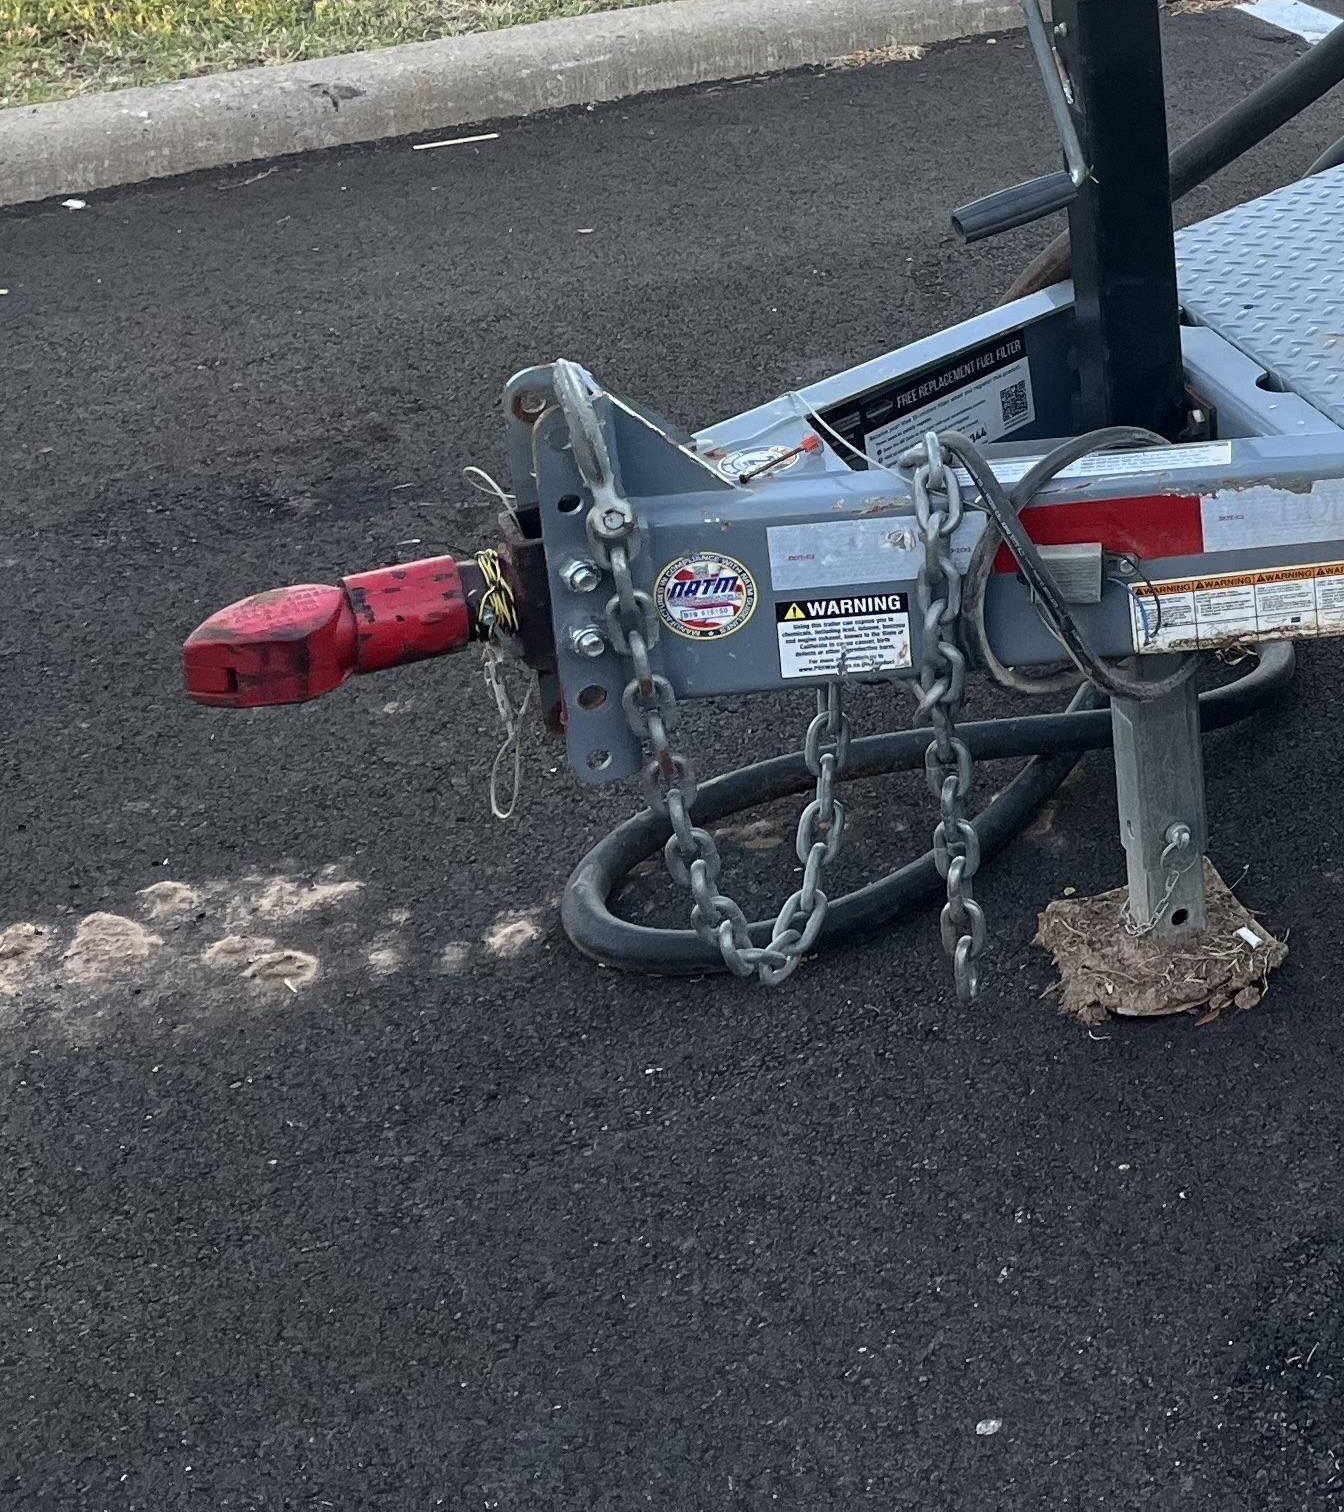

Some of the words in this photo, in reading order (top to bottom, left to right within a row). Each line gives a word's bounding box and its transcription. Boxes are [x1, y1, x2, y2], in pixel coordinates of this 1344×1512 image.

[897, 391, 919, 408] FREE
[918, 362, 975, 398] REPLACEMENT
[976, 357, 994, 371] FUEL
[996, 340, 1021, 361] FILTER
[1265, 569, 1313, 581] WARNING
[1204, 576, 1252, 588] WARNING
[1144, 583, 1191, 595] WARNING
[807, 595, 901, 617] WARNING
